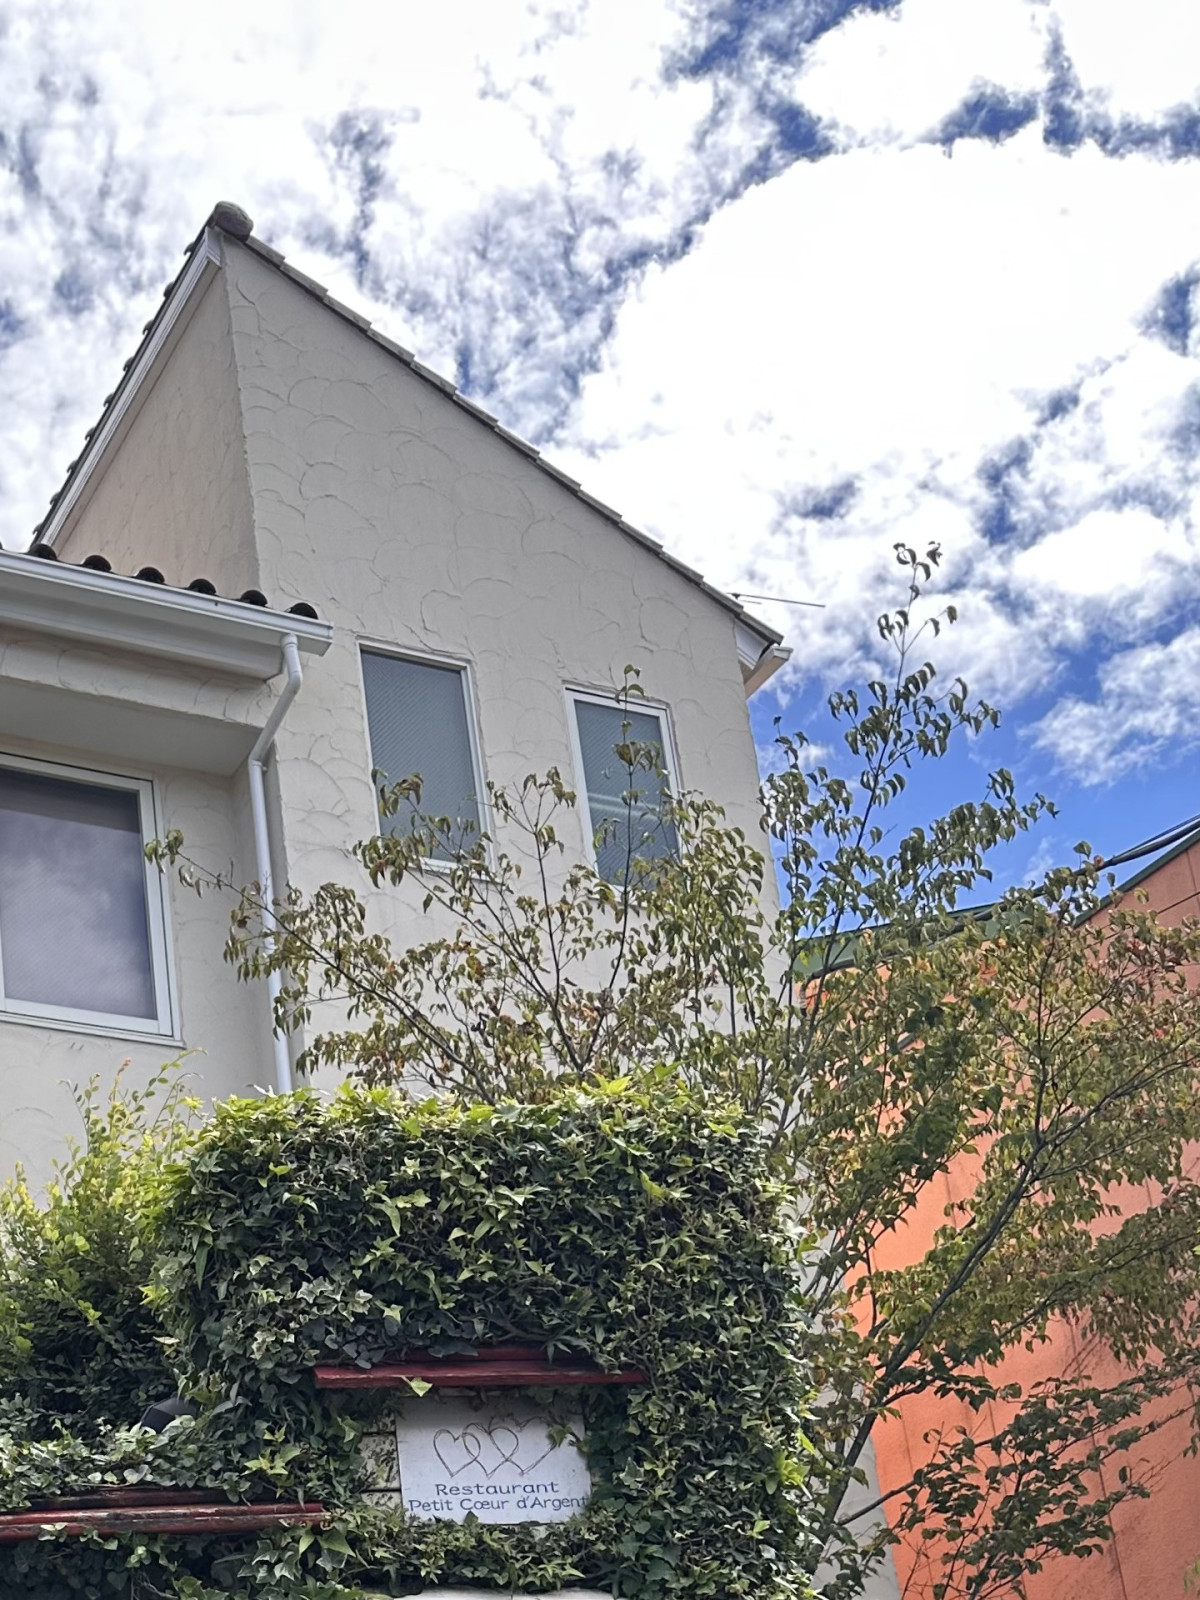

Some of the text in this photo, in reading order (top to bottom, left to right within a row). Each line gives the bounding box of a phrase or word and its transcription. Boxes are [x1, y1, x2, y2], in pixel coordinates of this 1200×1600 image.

[434, 1481, 560, 1496] Restaurant
[408, 1499, 453, 1512] Petit
[459, 1498, 509, 1511] Cœur
